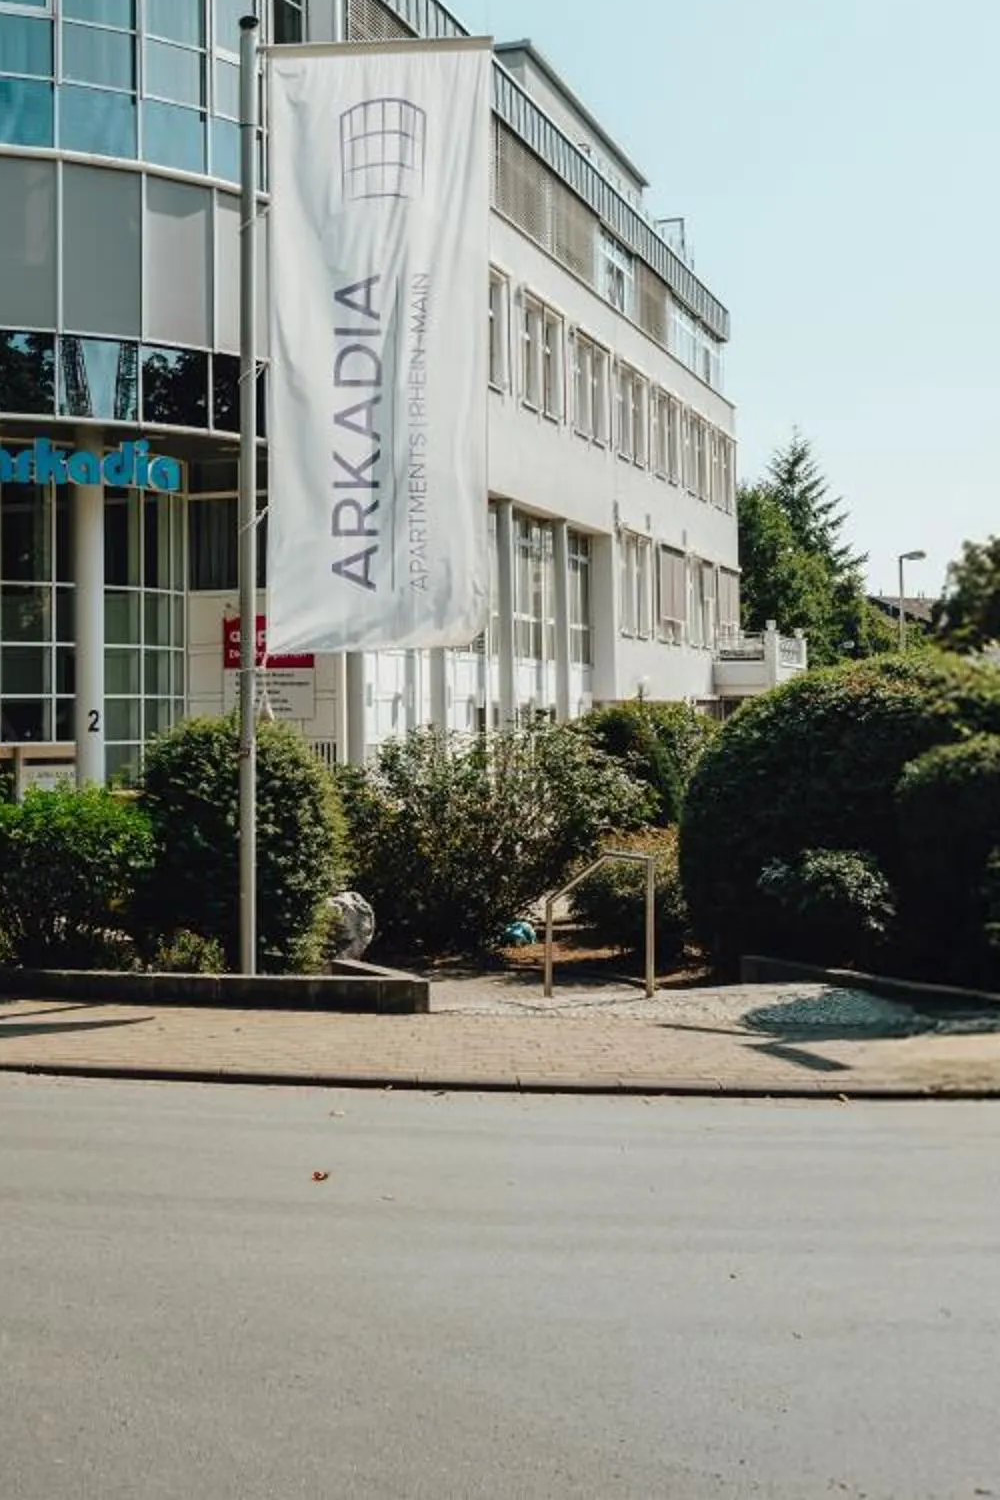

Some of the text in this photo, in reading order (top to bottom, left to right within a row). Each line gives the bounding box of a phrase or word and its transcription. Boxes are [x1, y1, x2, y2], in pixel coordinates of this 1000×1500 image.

[331, 274, 382, 592] ARKADIA
[408, 431, 429, 593] APARTMENTS
[87, 709, 100, 733] 2
